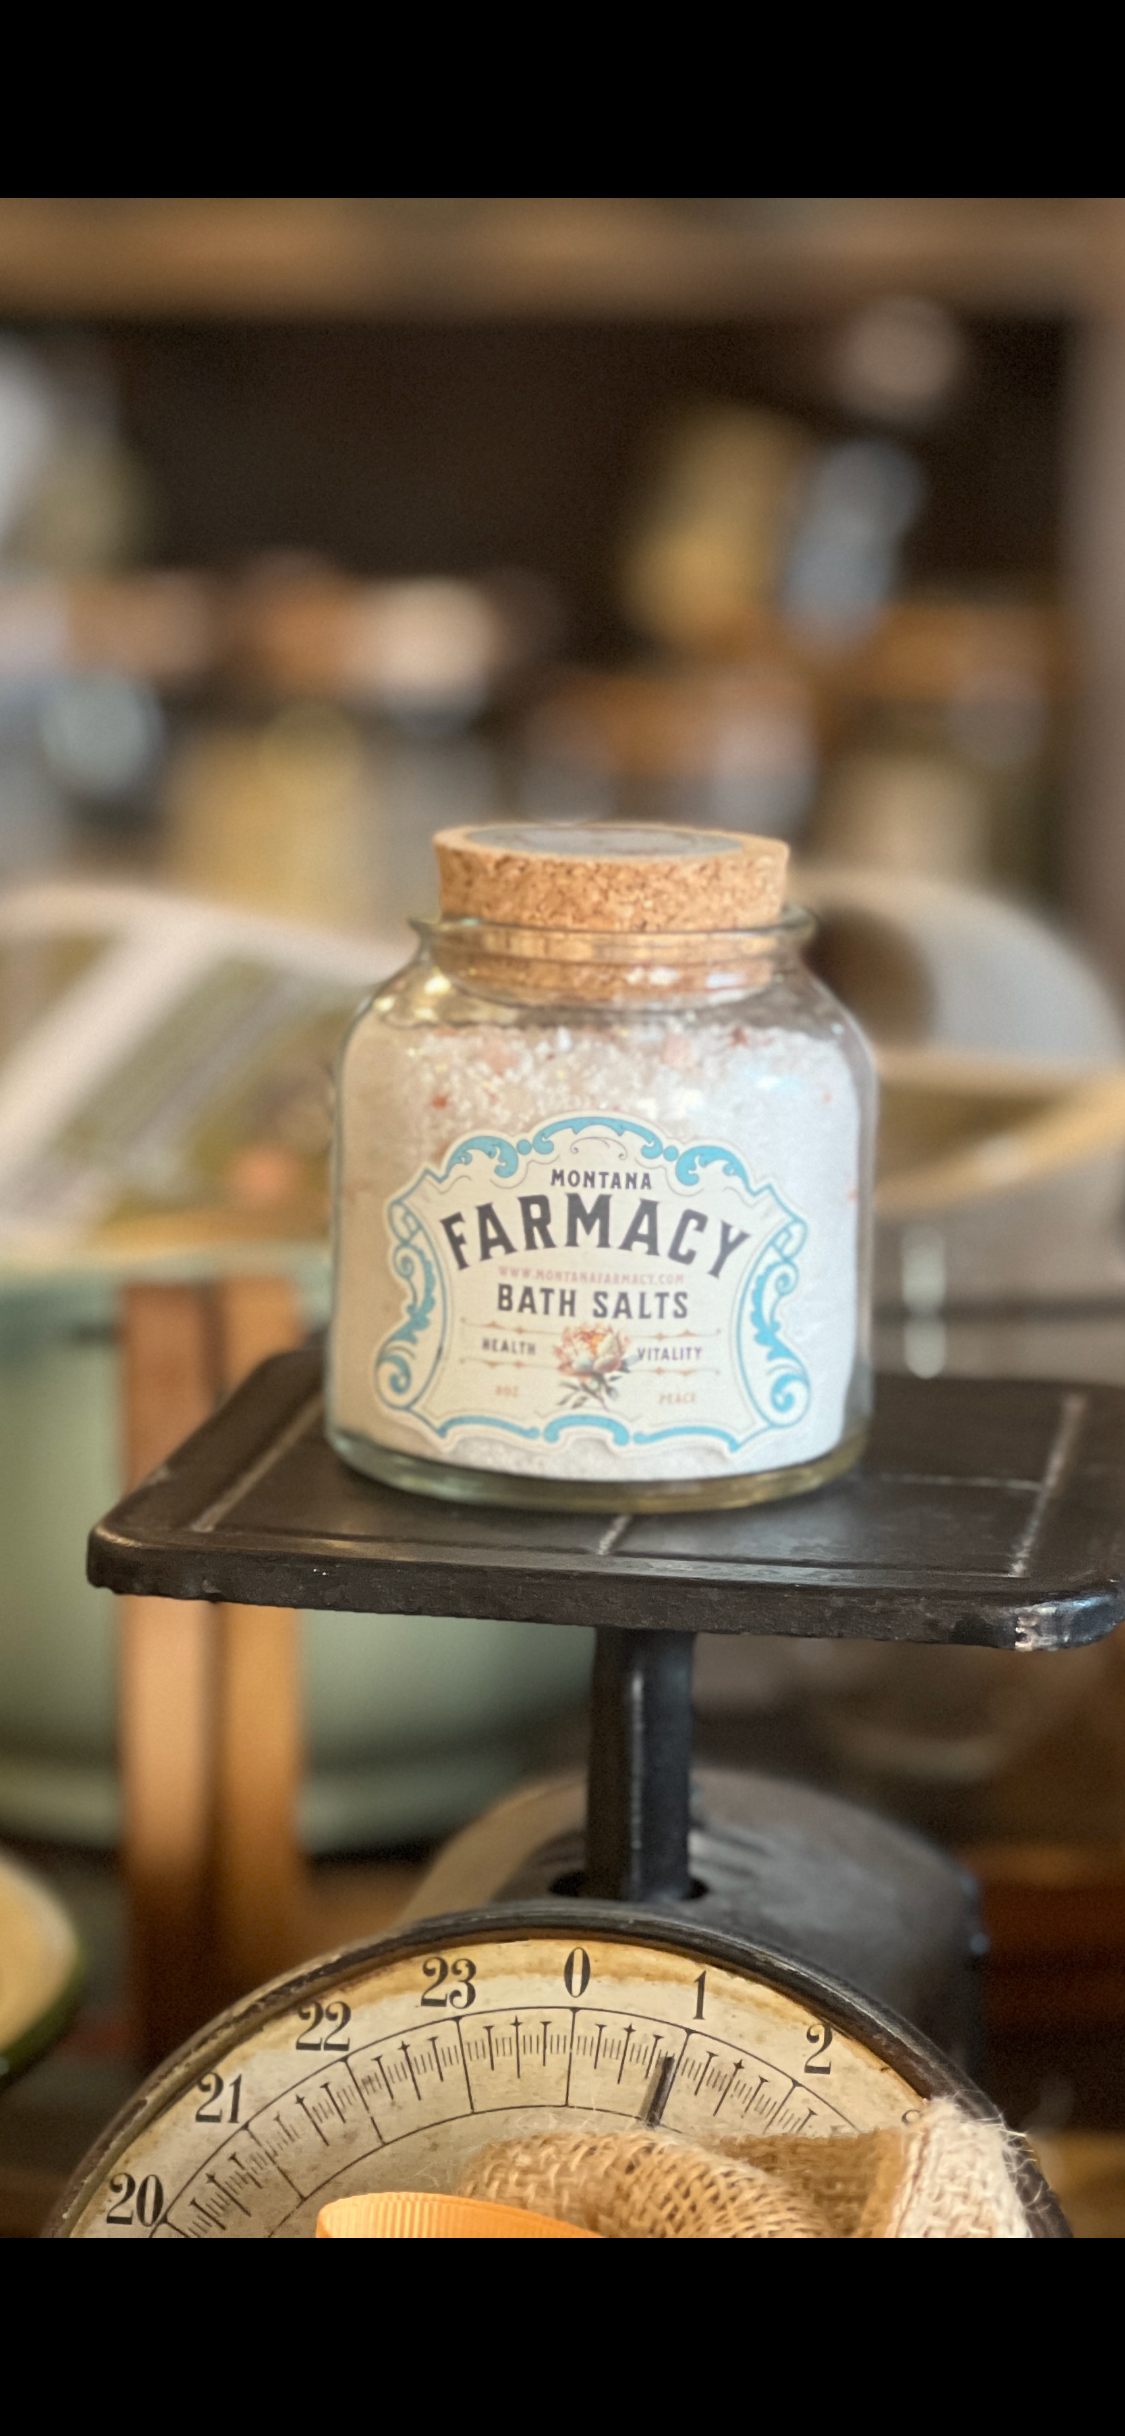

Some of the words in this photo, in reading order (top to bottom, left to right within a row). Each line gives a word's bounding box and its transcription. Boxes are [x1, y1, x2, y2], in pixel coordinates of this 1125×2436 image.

[550, 1168, 653, 1190] MONTANA
[439, 1192, 752, 1279] FARMACY
[497, 1283, 577, 1318] BATH
[592, 1290, 689, 1320] SALTS
[498, 1266, 685, 1286] WWW.MONTANAFARMACY.COM
[481, 1337, 537, 1356] HEALTH
[636, 1346, 703, 1362] VITALITY
[420, 1957, 477, 2009] 23
[563, 1946, 591, 1998] 0
[692, 1970, 706, 2020] 1
[295, 2001, 352, 2052] 22
[804, 2023, 833, 2075] 2
[195, 2072, 243, 2124] 21
[106, 2173, 164, 2227] 20
